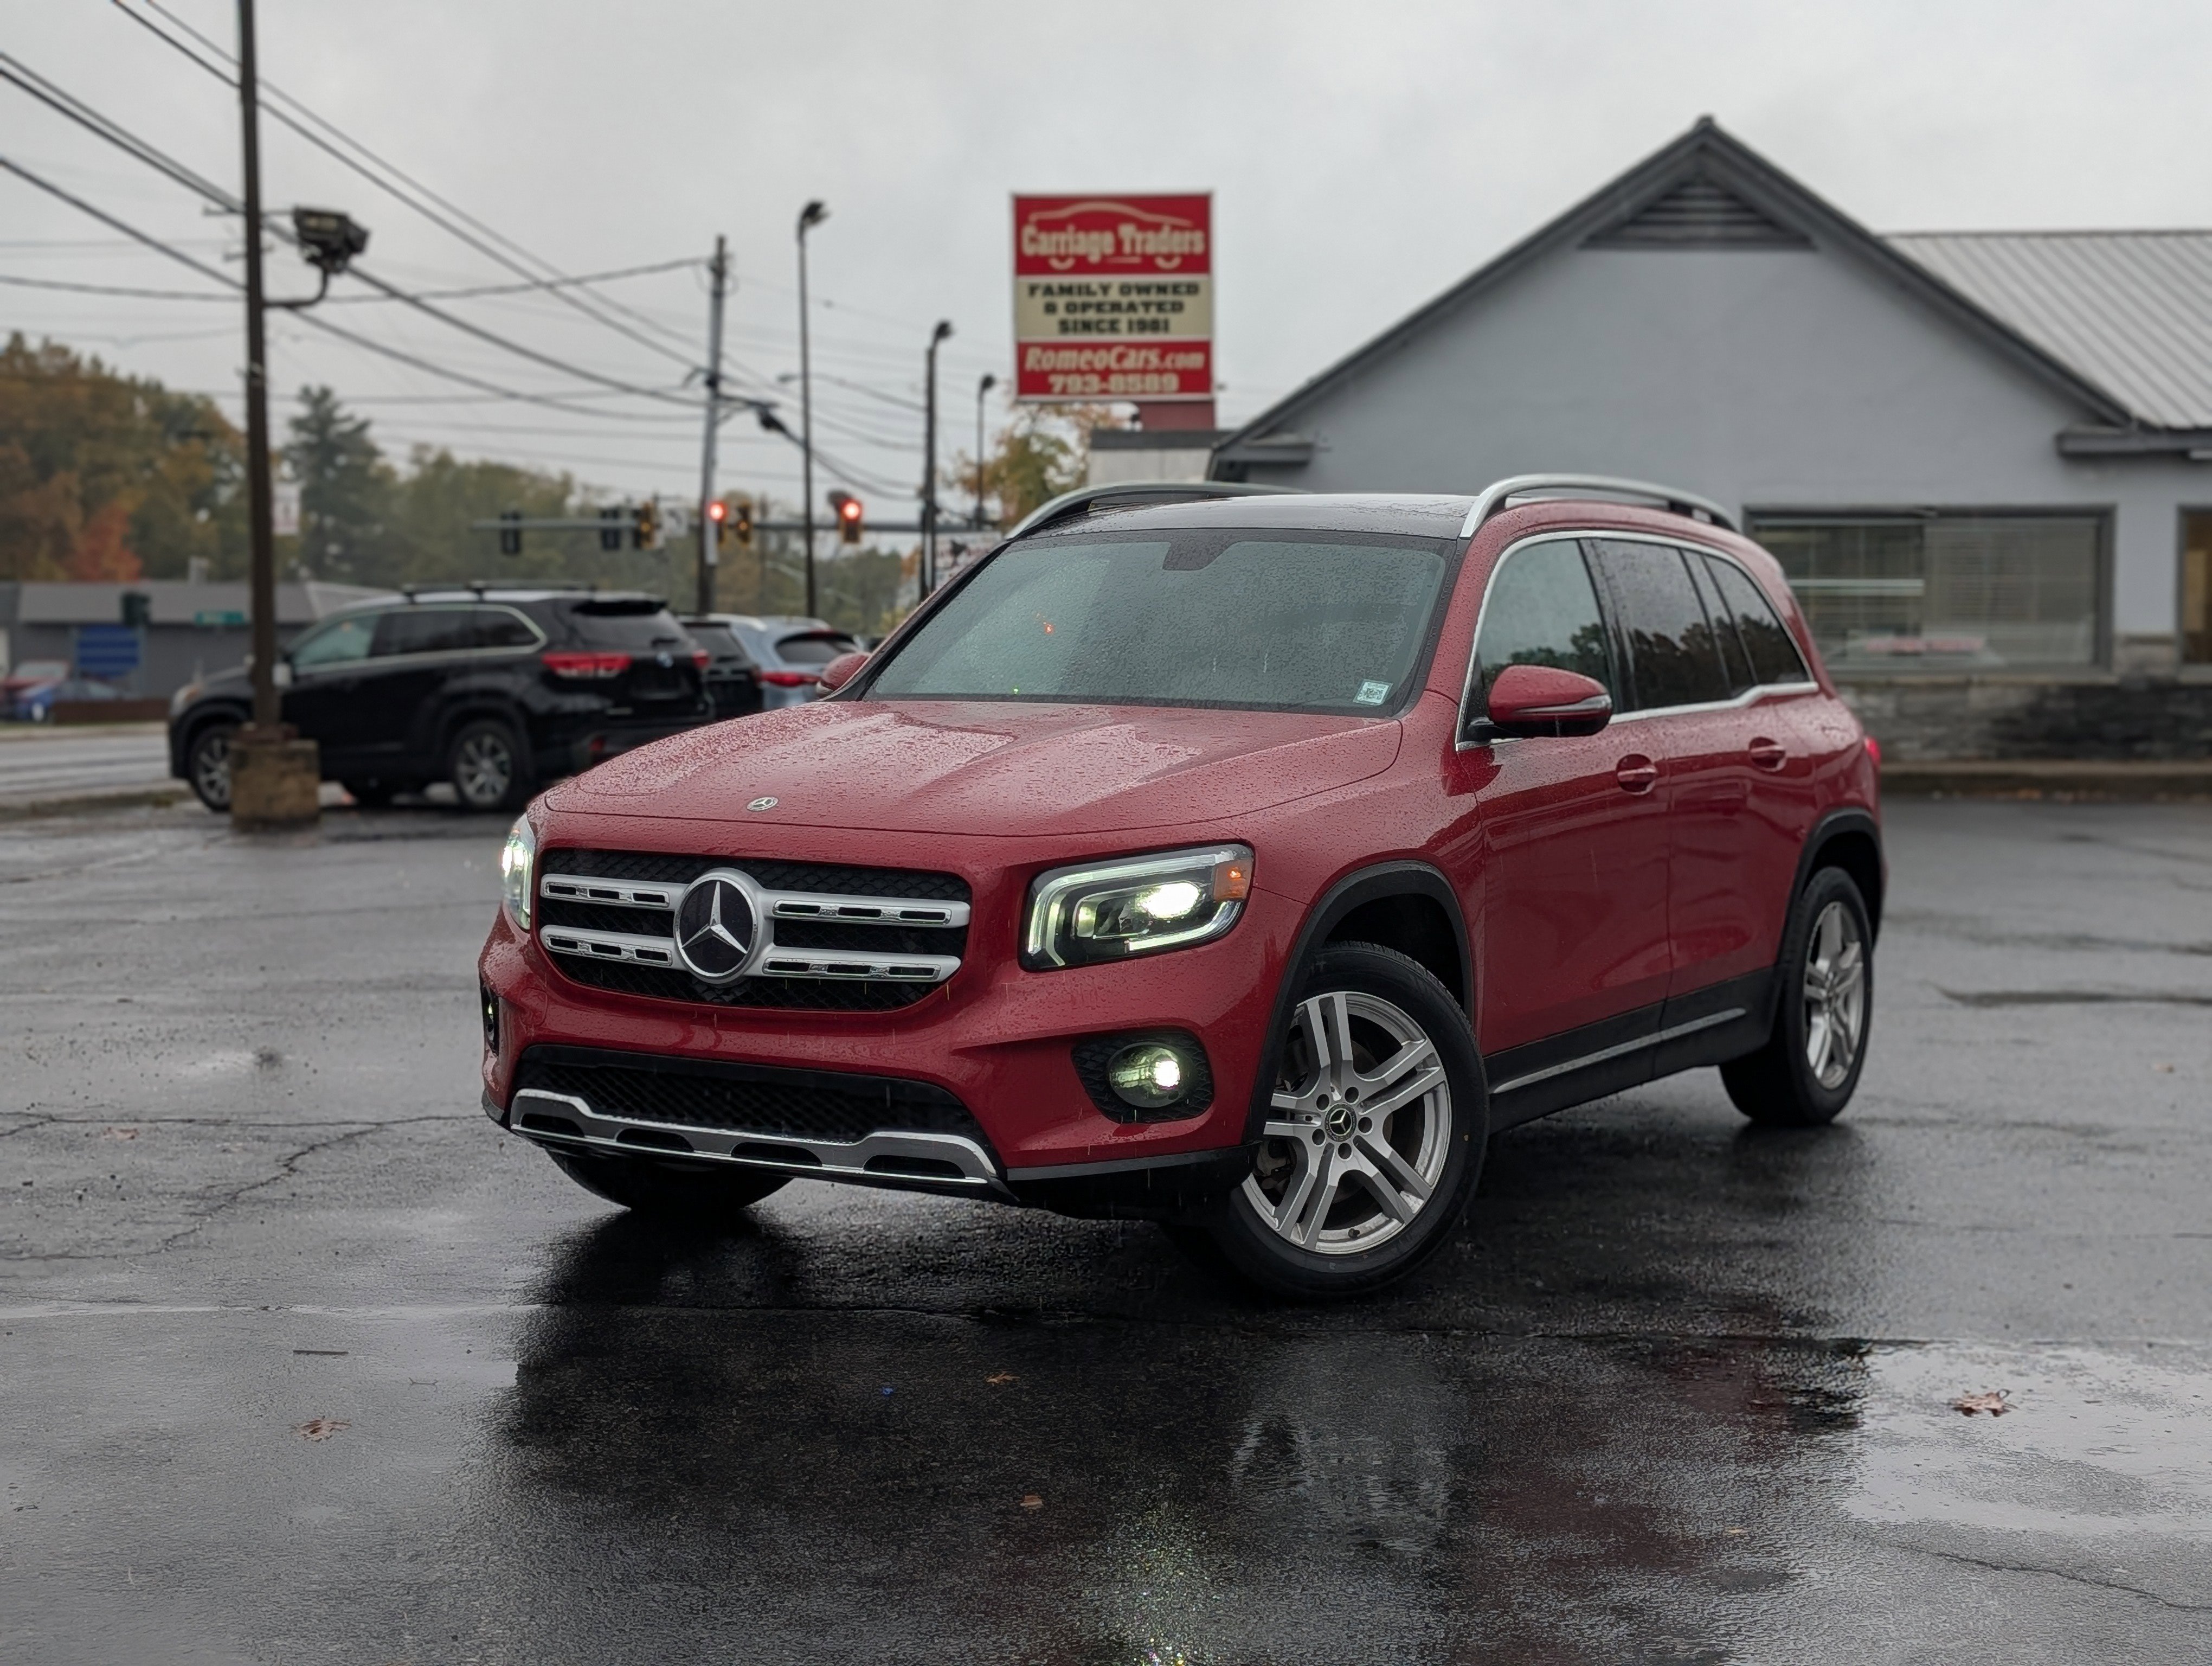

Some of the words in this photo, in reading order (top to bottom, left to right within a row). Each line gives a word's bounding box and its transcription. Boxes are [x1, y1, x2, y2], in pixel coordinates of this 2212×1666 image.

[1117, 222, 1205, 255] Traders
[1028, 283, 1111, 297] FAMILY
[1118, 282, 1199, 296] OWNED
[1065, 300, 1185, 314] OPERATED
[1059, 318, 1121, 334] SINCE
[1025, 345, 1205, 372] RomeoCars.com
